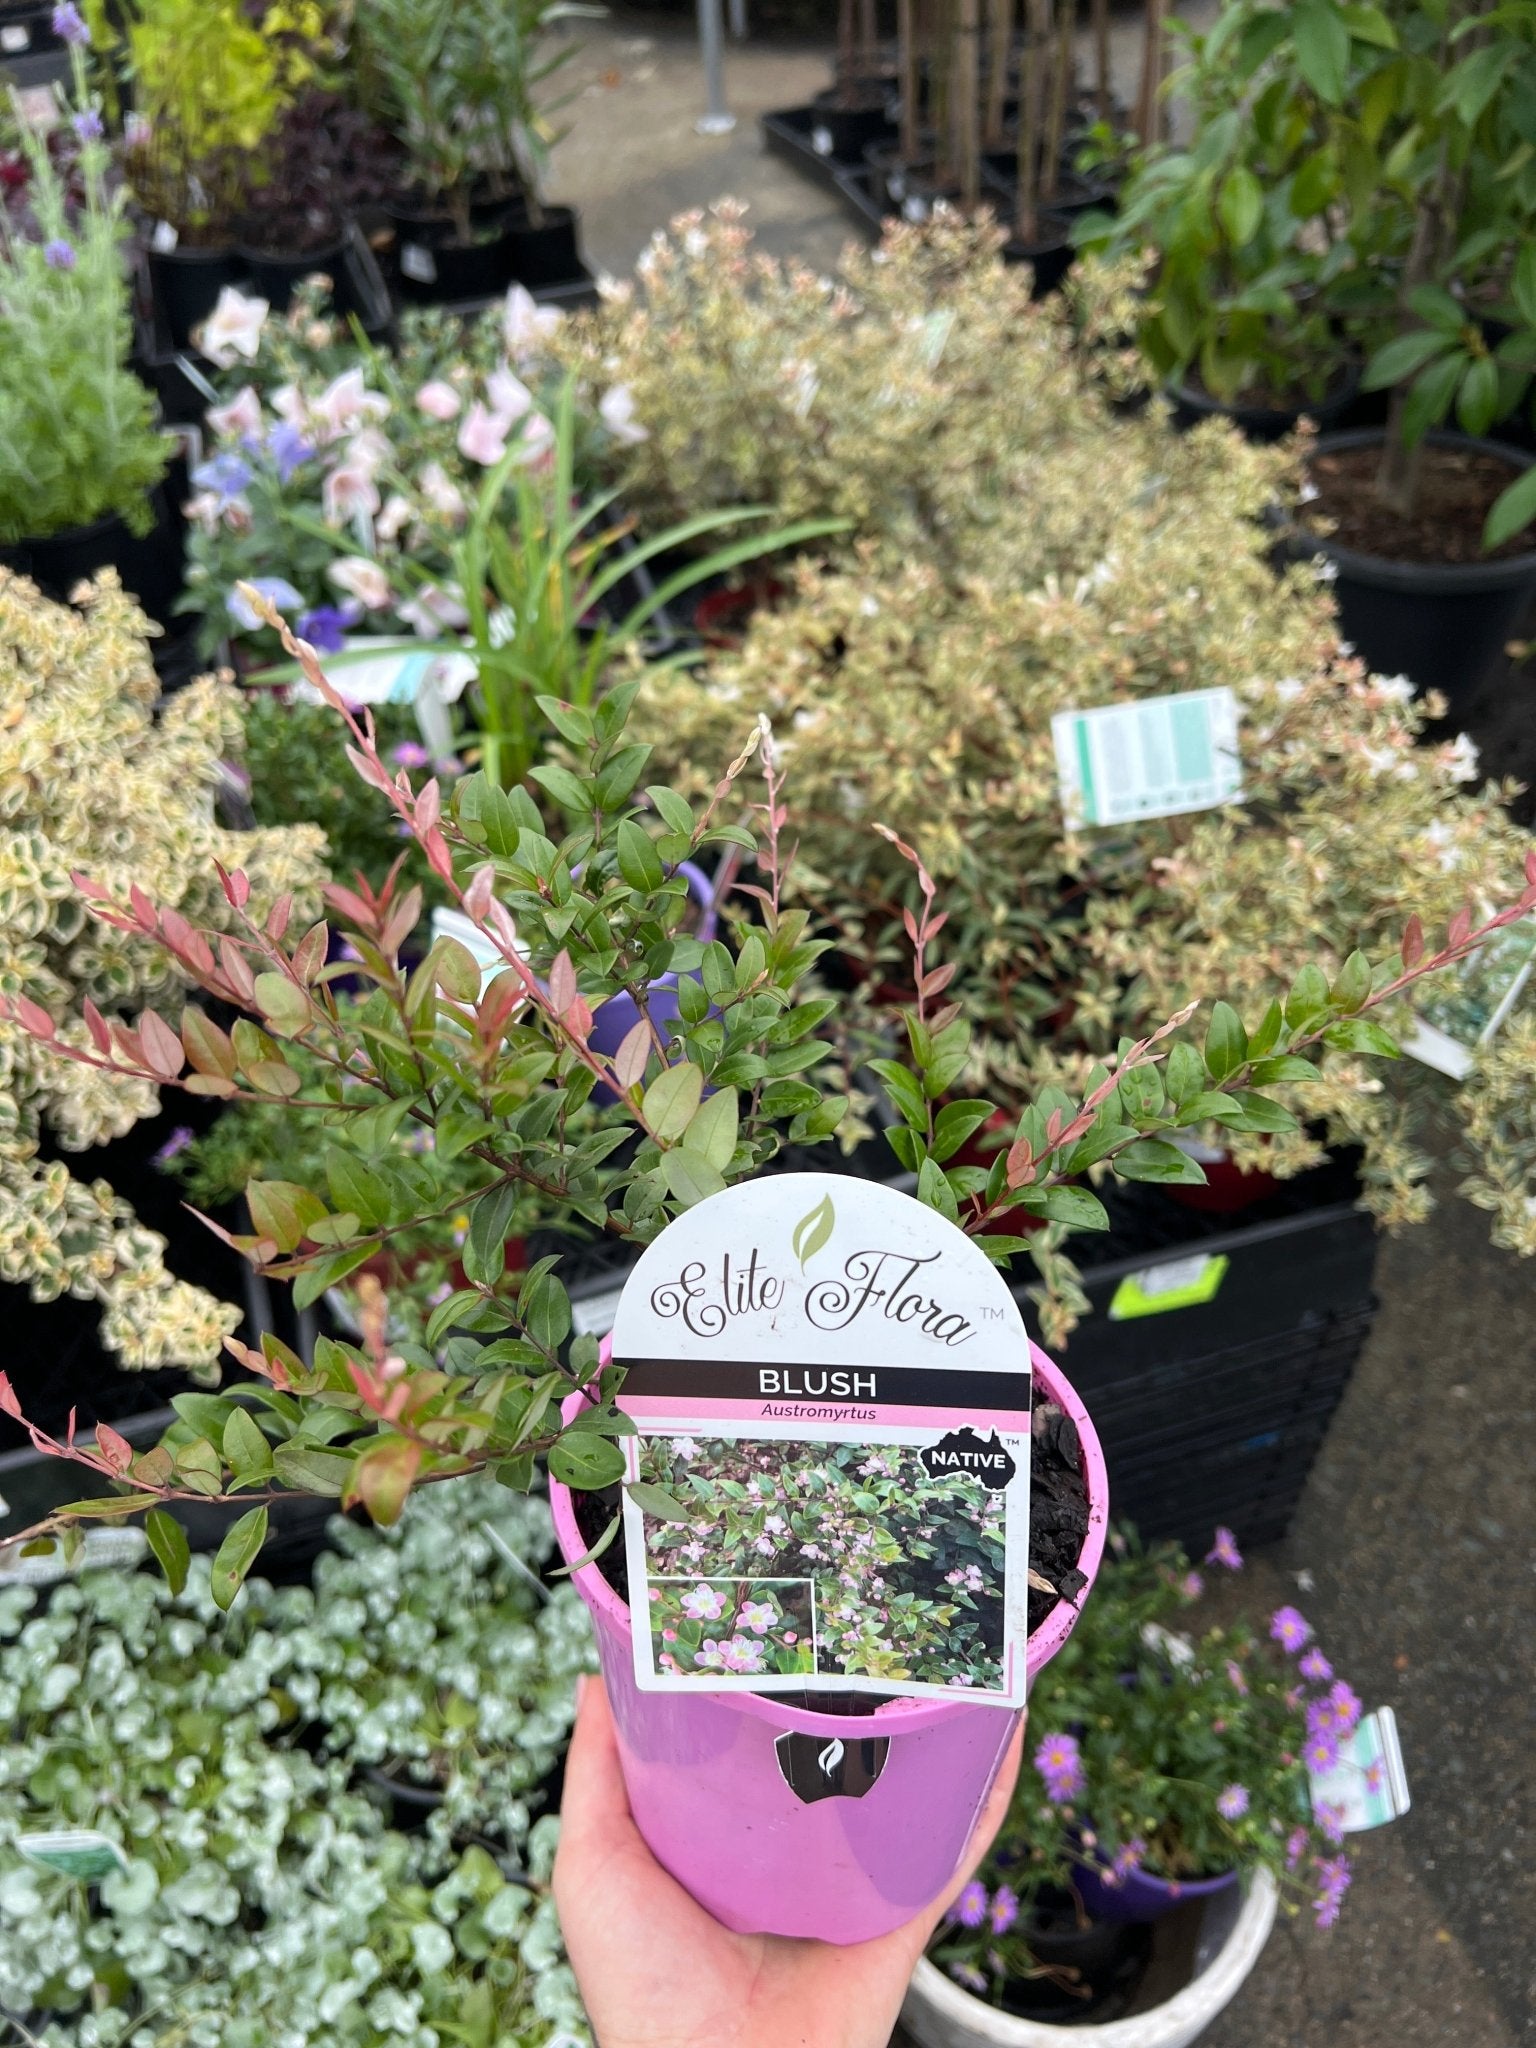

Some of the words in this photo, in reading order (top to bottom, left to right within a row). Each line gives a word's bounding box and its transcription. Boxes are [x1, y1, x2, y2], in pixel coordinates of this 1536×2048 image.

[651, 1248, 785, 1337] Elite
[805, 1250, 977, 1346] Flora
[759, 1369, 877, 1397] BLUSH
[761, 1403, 877, 1422] Austromyrtus
[931, 1450, 1006, 1469] NATIVE
